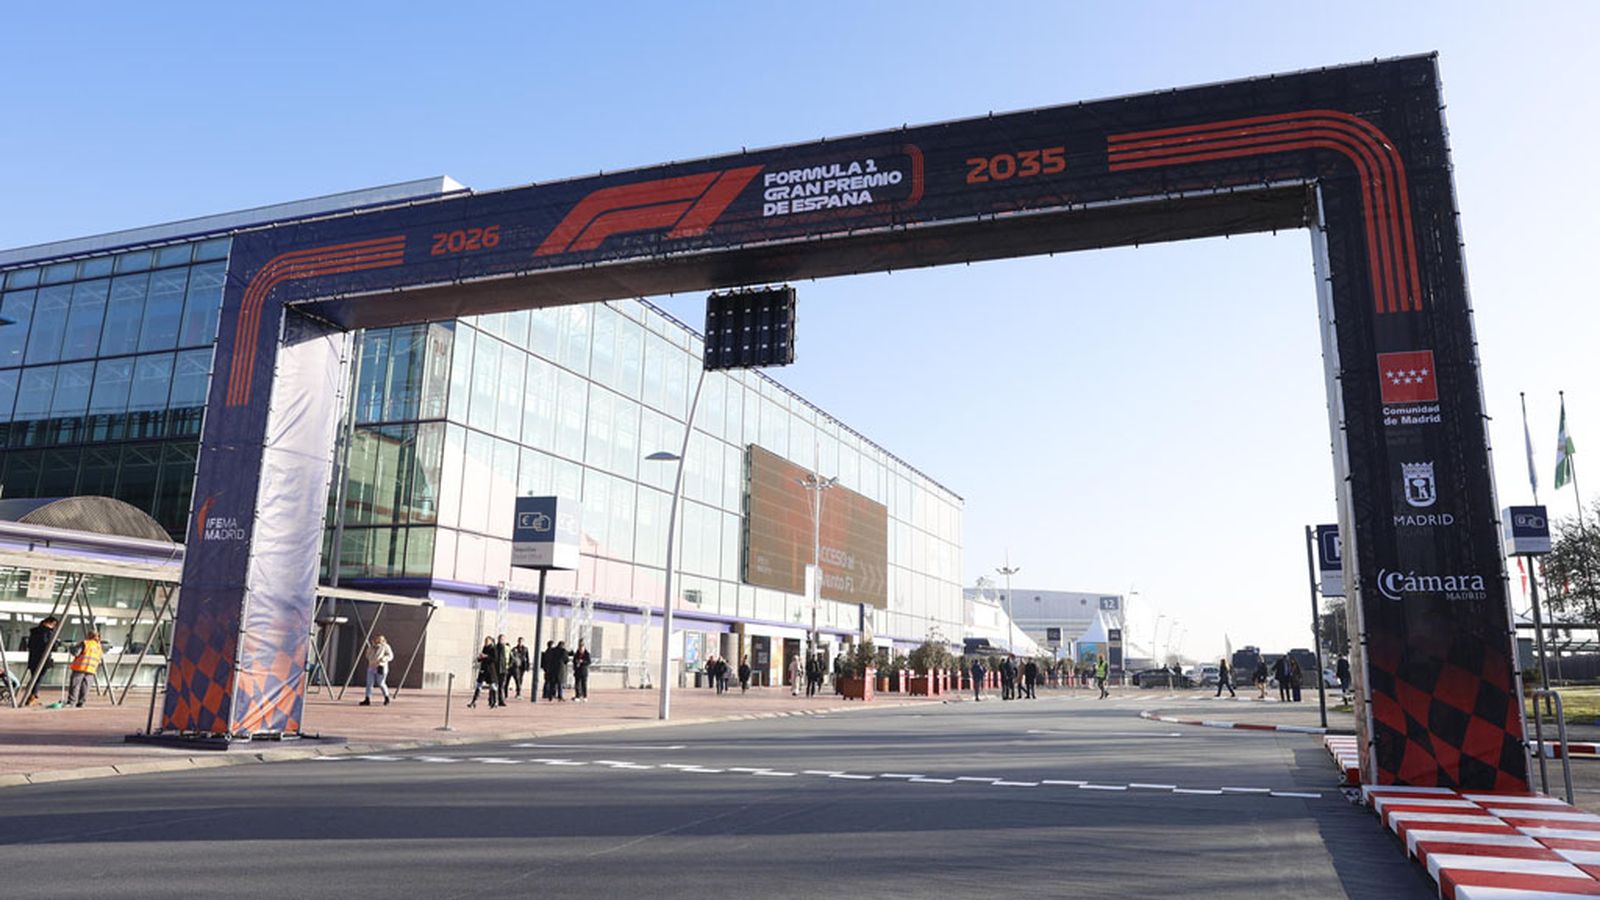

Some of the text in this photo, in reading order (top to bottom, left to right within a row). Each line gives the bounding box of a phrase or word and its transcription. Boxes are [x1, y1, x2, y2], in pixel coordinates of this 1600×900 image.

[966, 147, 1066, 184] 2035
[764, 159, 877, 186] FORMULA 1
[764, 171, 902, 200] GRAN PREMIO
[763, 202, 789, 216] DE
[431, 225, 500, 256] 2026
[1382, 405, 1440, 415] Comunidad
[1383, 415, 1441, 426] de Madrid
[206, 518, 237, 529] IFEMA
[1393, 513, 1454, 526] MADRID
[204, 529, 245, 540] MADRID
[1385, 571, 1486, 592] Cámara
[1445, 592, 1487, 600] MADRID
[1104, 600, 1116, 609] 12
